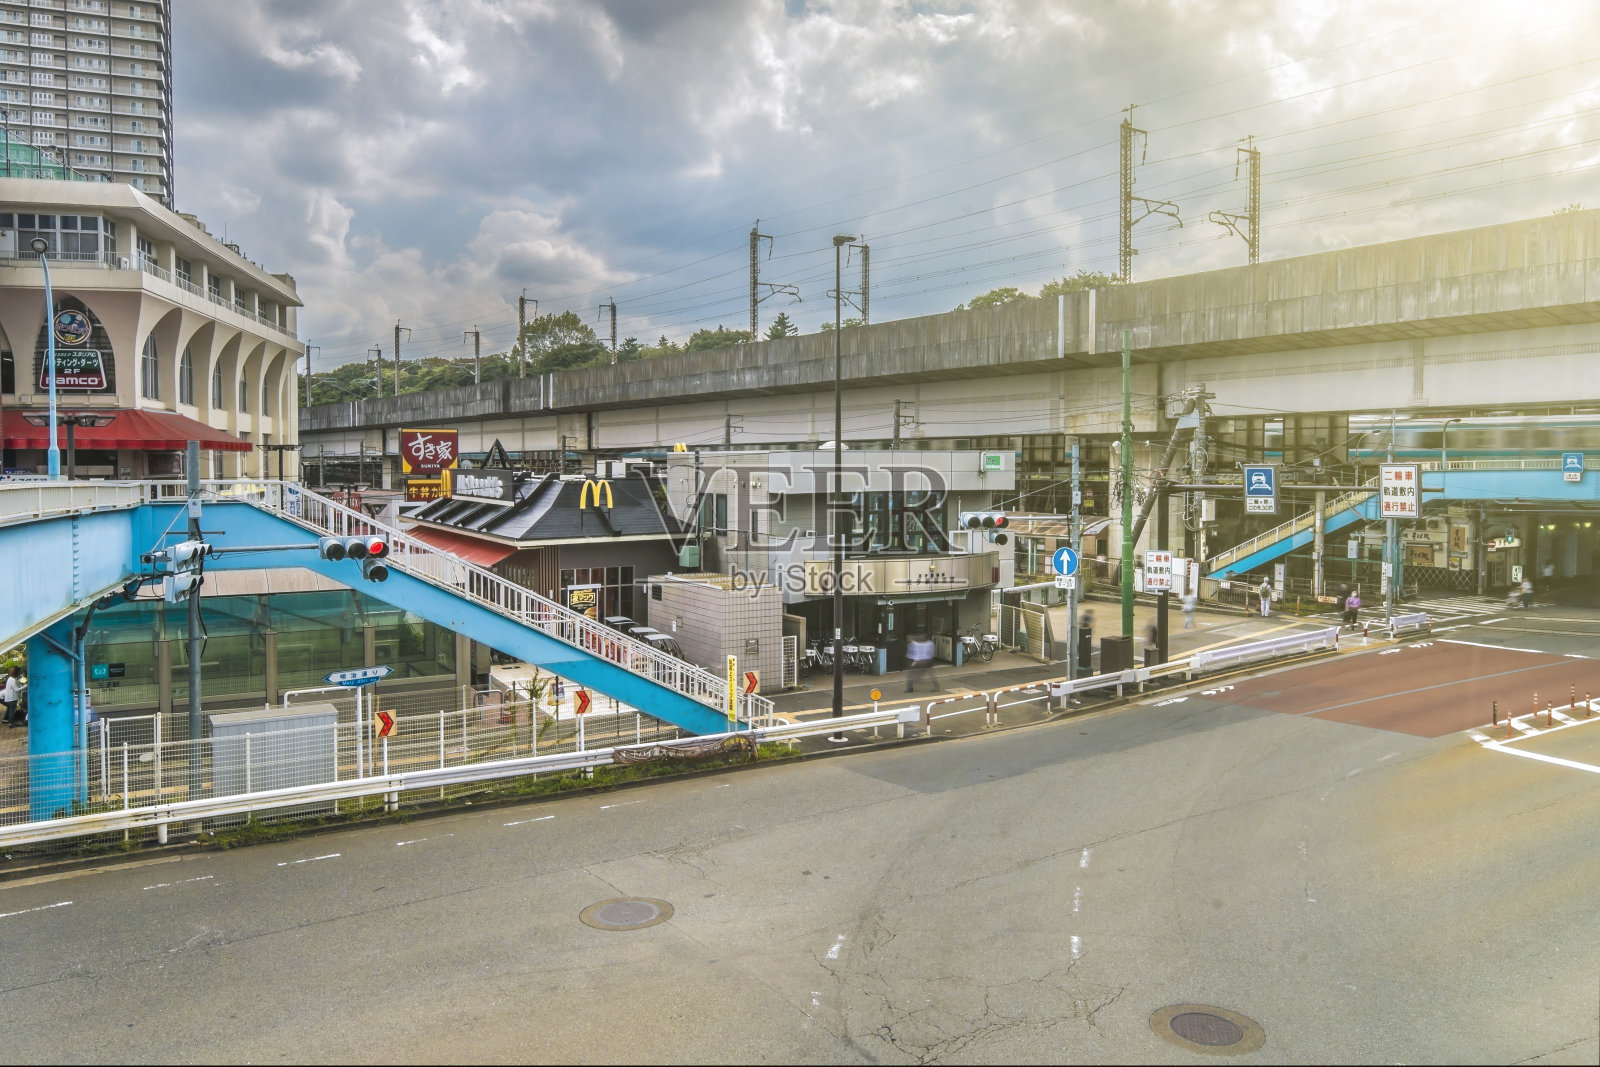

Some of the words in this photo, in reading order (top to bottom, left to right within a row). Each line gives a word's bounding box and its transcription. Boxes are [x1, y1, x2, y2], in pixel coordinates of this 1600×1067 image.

[46, 359, 99, 367] ティング・ダーツ
[408, 432, 453, 463] すき家
[1384, 470, 1413, 481] 二輪車
[1383, 486, 1415, 497] 軌道敷内
[1384, 501, 1415, 512] 通行禁止
[1147, 554, 1170, 562] 二輪車
[1147, 578, 1170, 586] 通行禁止
[340, 670, 378, 680] 明治通り
